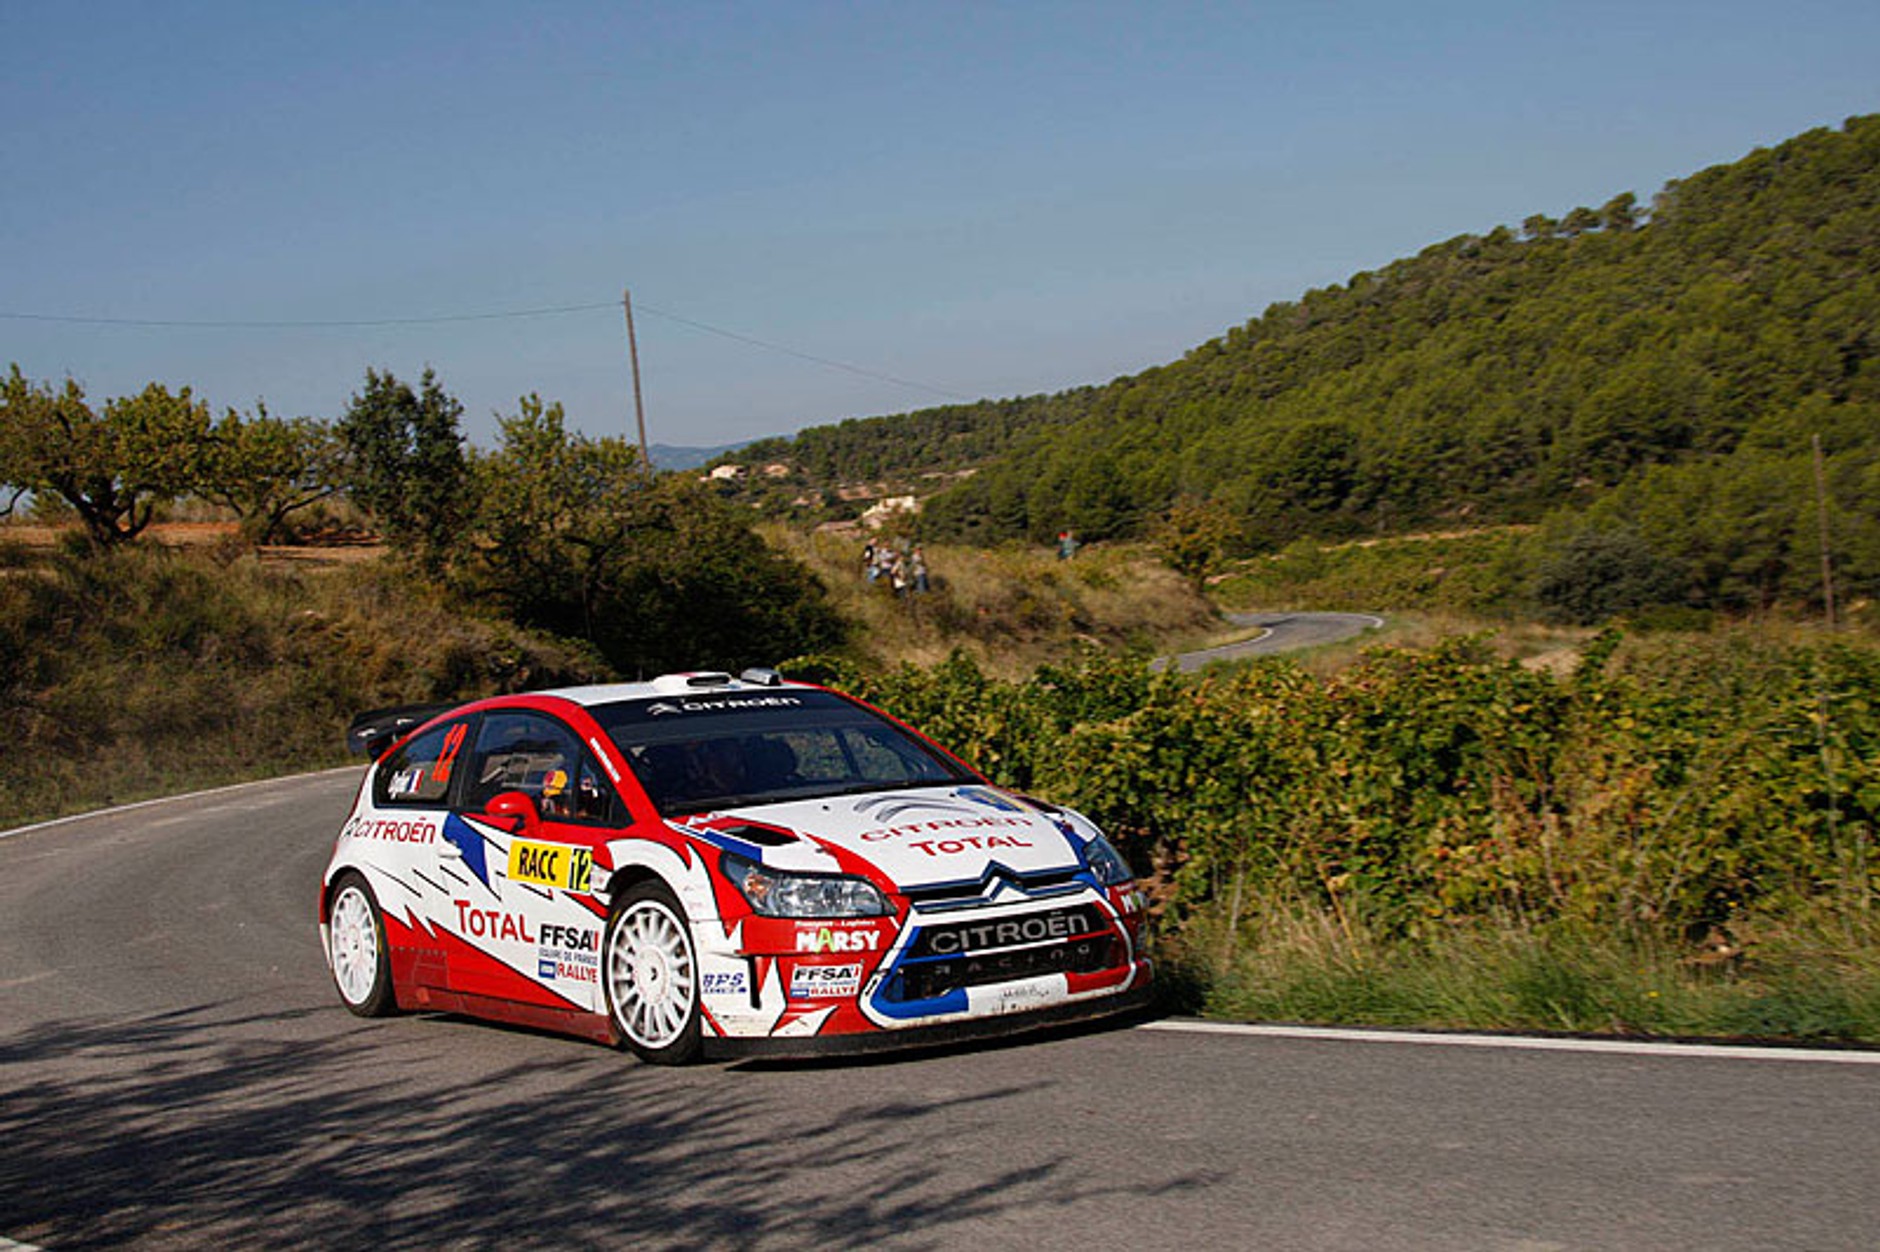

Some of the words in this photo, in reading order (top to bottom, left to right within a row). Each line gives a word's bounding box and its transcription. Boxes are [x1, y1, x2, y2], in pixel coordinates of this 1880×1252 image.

[908, 835, 1033, 857] TOTAL
[517, 846, 559, 882] RACC
[453, 899, 535, 944] TOTAL
[796, 927, 881, 954] MARSY
[557, 962, 598, 983] RALLYE
